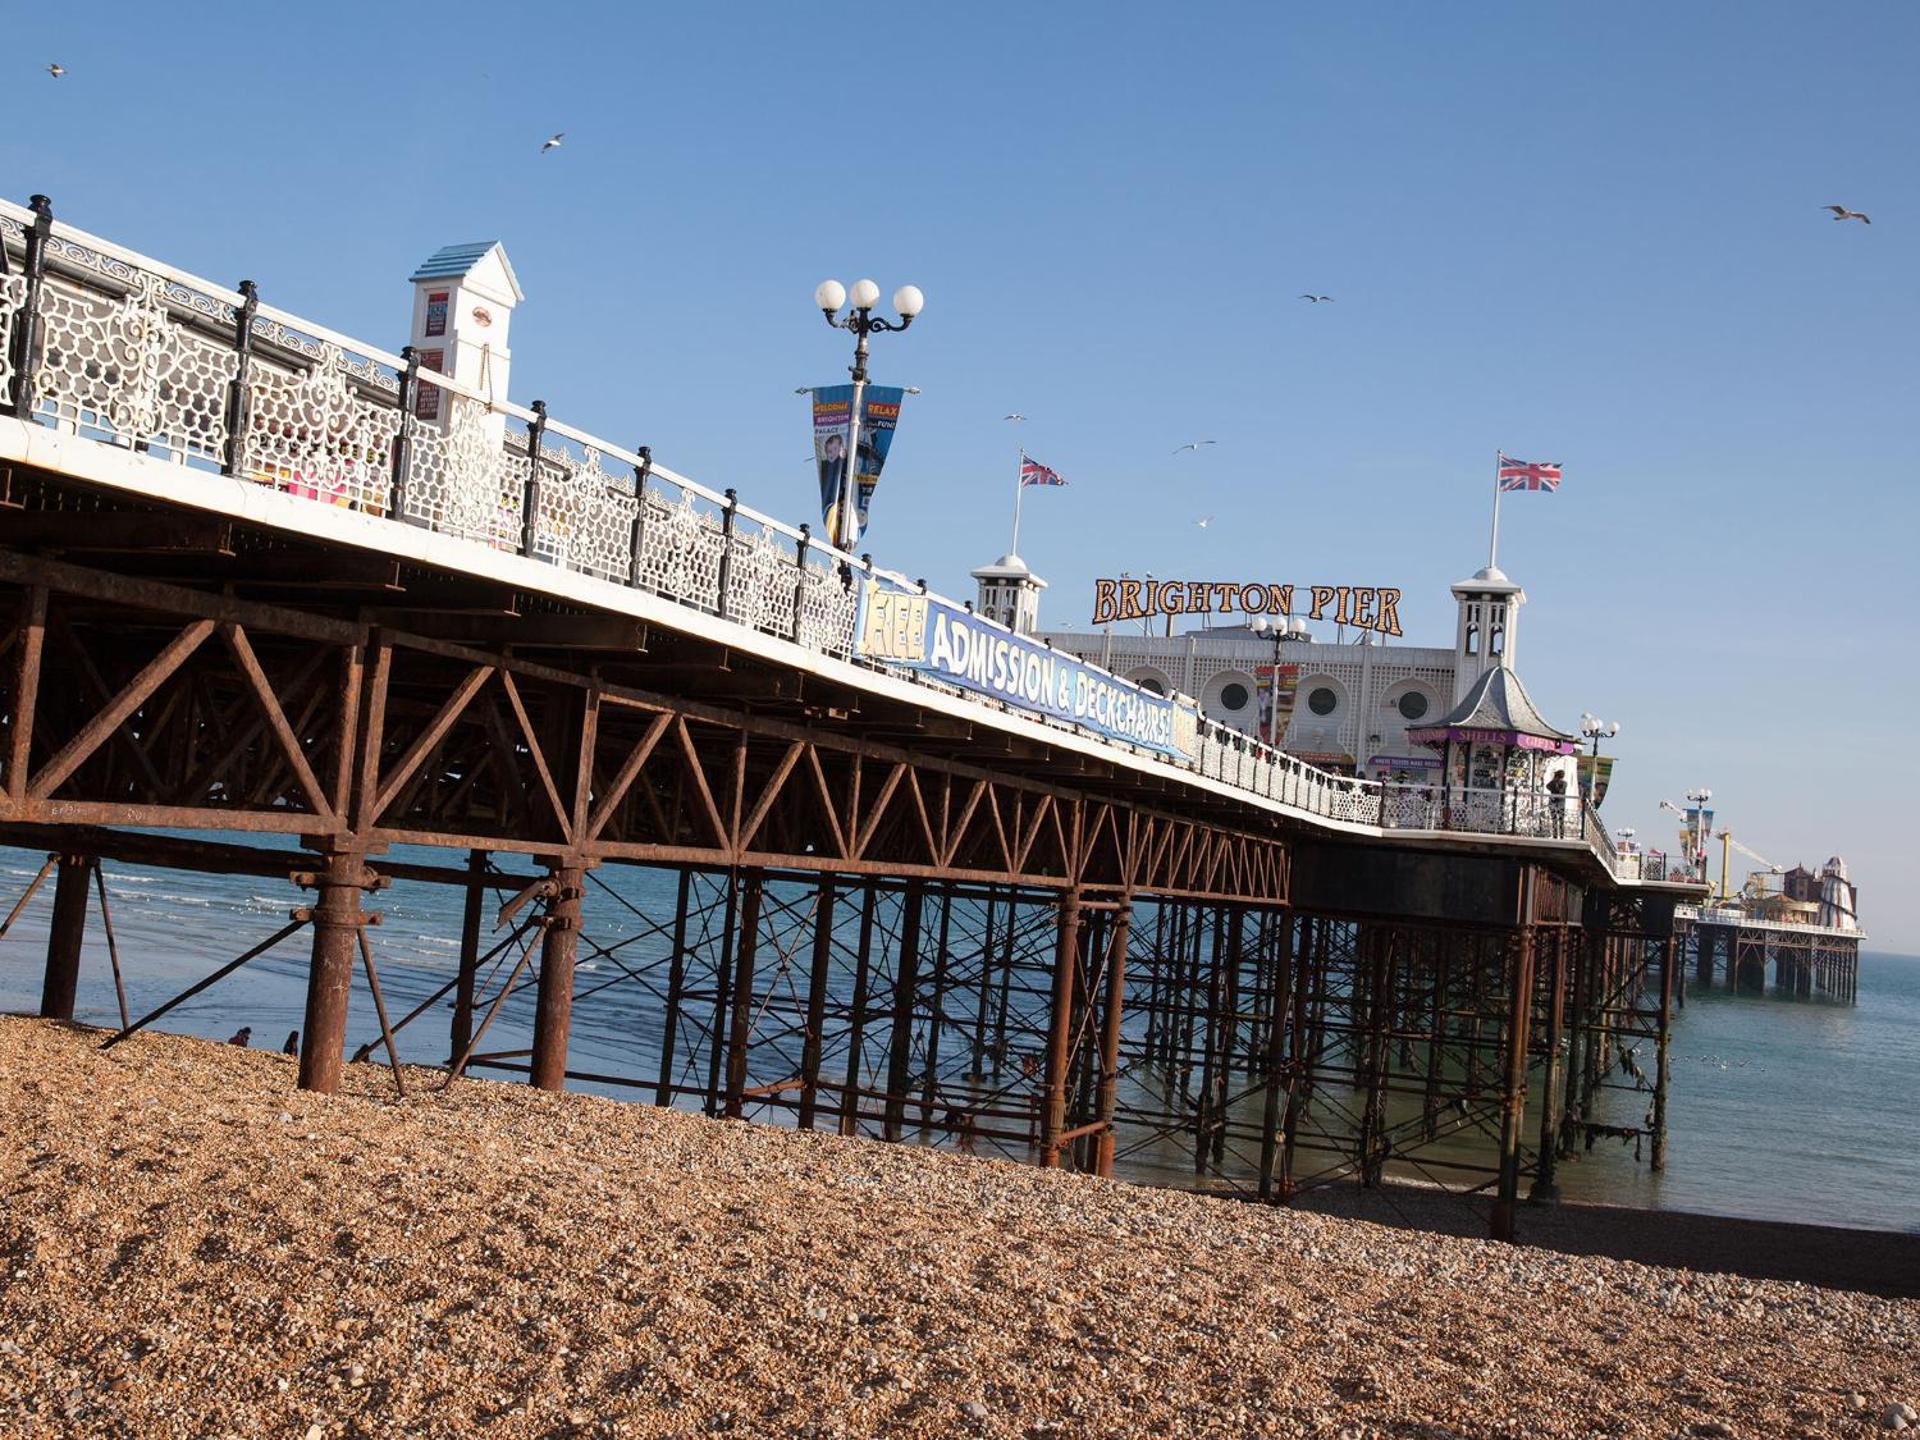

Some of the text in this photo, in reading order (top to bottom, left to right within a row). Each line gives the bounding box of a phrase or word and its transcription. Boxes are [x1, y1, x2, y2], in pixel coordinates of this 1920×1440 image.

[868, 403, 898, 417] RELAX
[1092, 579, 1403, 637] BRIGHTON PIER
[931, 612, 1056, 709] ADMISSION
[1057, 667, 1070, 712] &
[1075, 671, 1172, 748] DECKCHAIRS!
[1460, 730, 1507, 742] SHELLS
